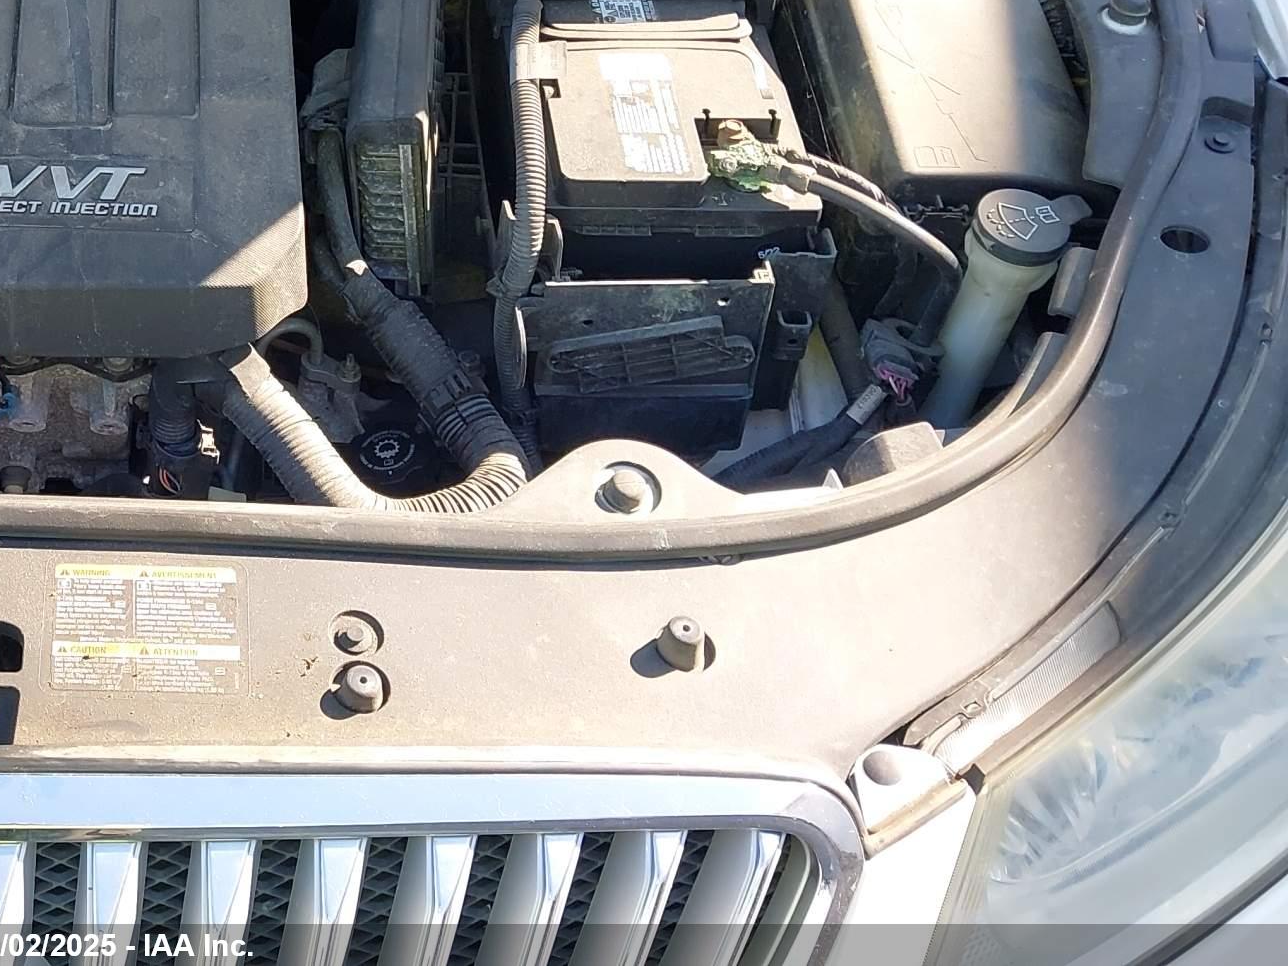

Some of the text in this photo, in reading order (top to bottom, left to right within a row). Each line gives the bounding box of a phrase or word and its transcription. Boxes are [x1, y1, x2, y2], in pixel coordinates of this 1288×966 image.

[50, 202, 158, 217] INJECTION
[72, 568, 111, 577] WARNING
[70, 645, 107, 654] CAUTION
[153, 648, 199, 656] ATTENTION
